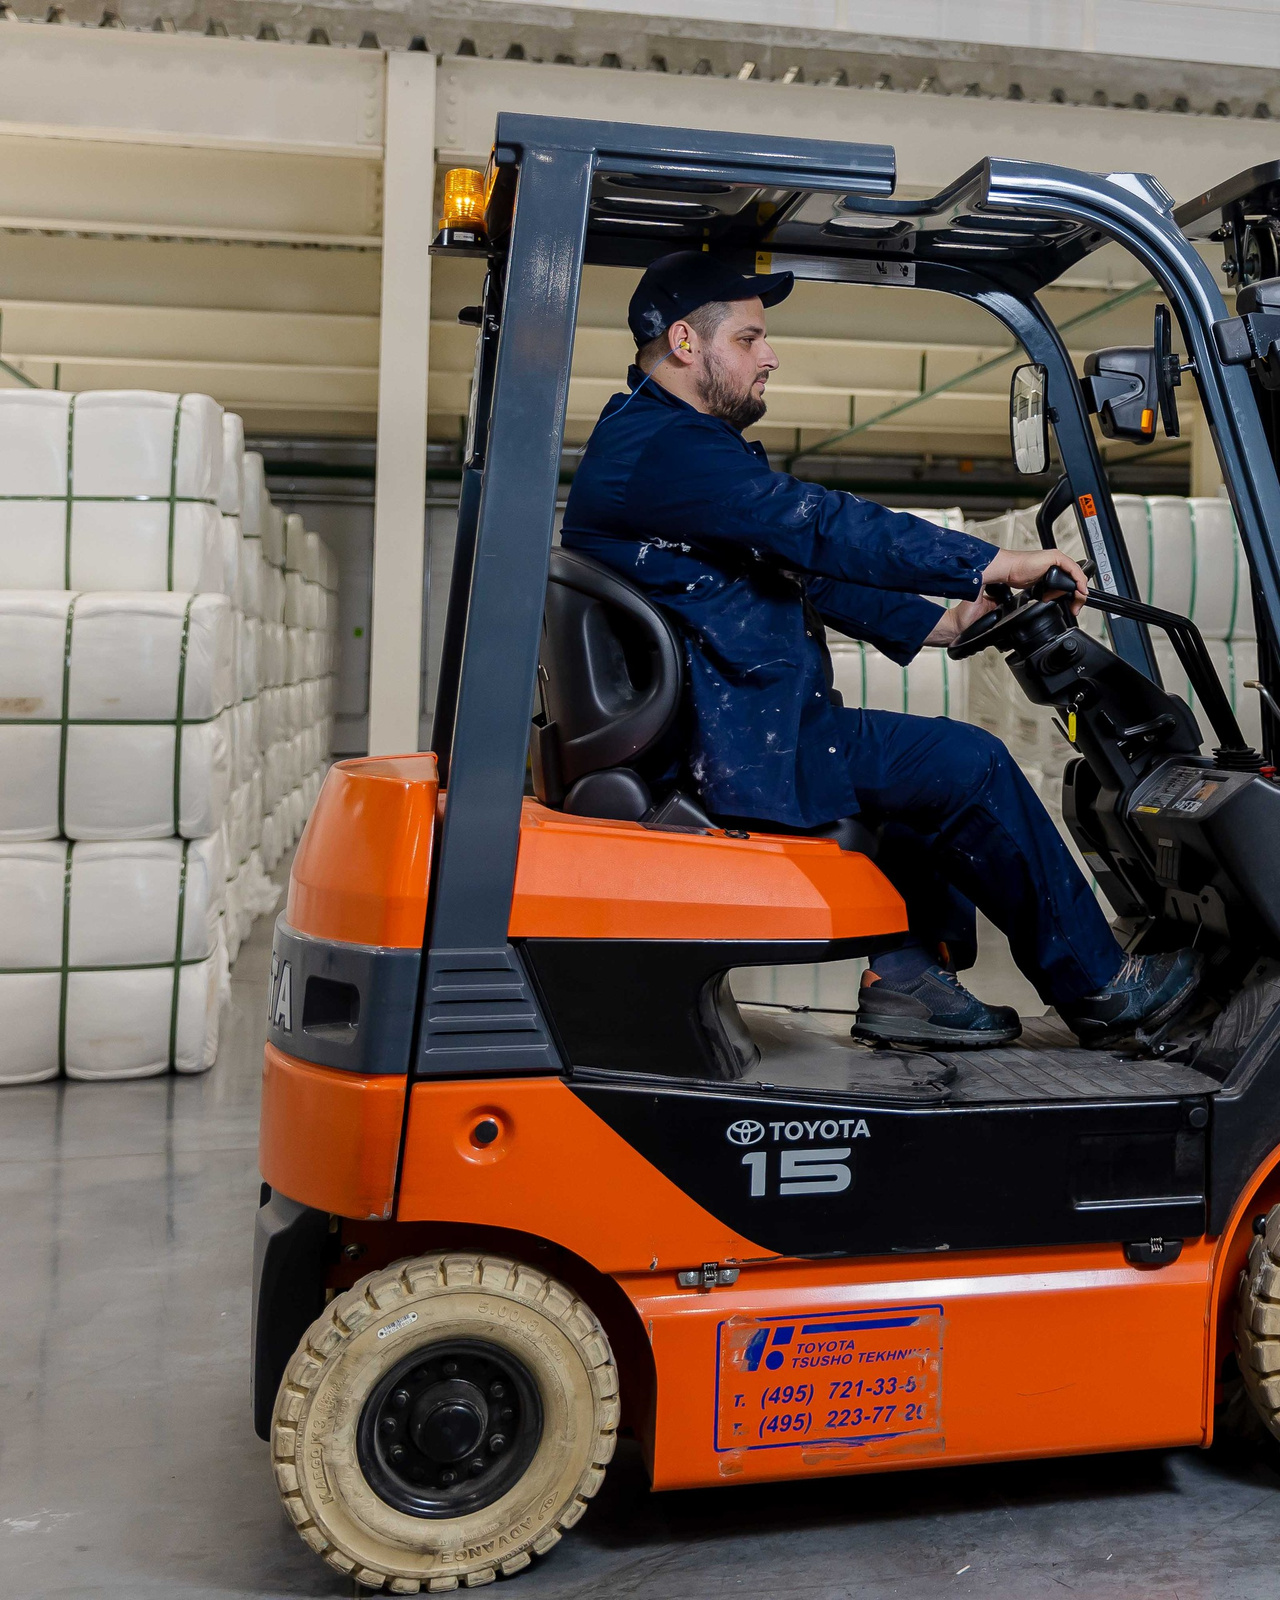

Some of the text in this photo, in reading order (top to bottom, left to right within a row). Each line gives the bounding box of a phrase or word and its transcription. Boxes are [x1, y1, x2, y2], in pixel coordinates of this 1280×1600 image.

[769, 1119, 871, 1141] TOYOTA
[741, 1148, 852, 1197] 15
[796, 1339, 856, 1354] TOYOTA
[791, 1353, 854, 1369] TSUSHO
[761, 1383, 815, 1410] (495)
[758, 1412, 813, 1439] (495)
[441, 1516, 533, 1564] ADVANCE
